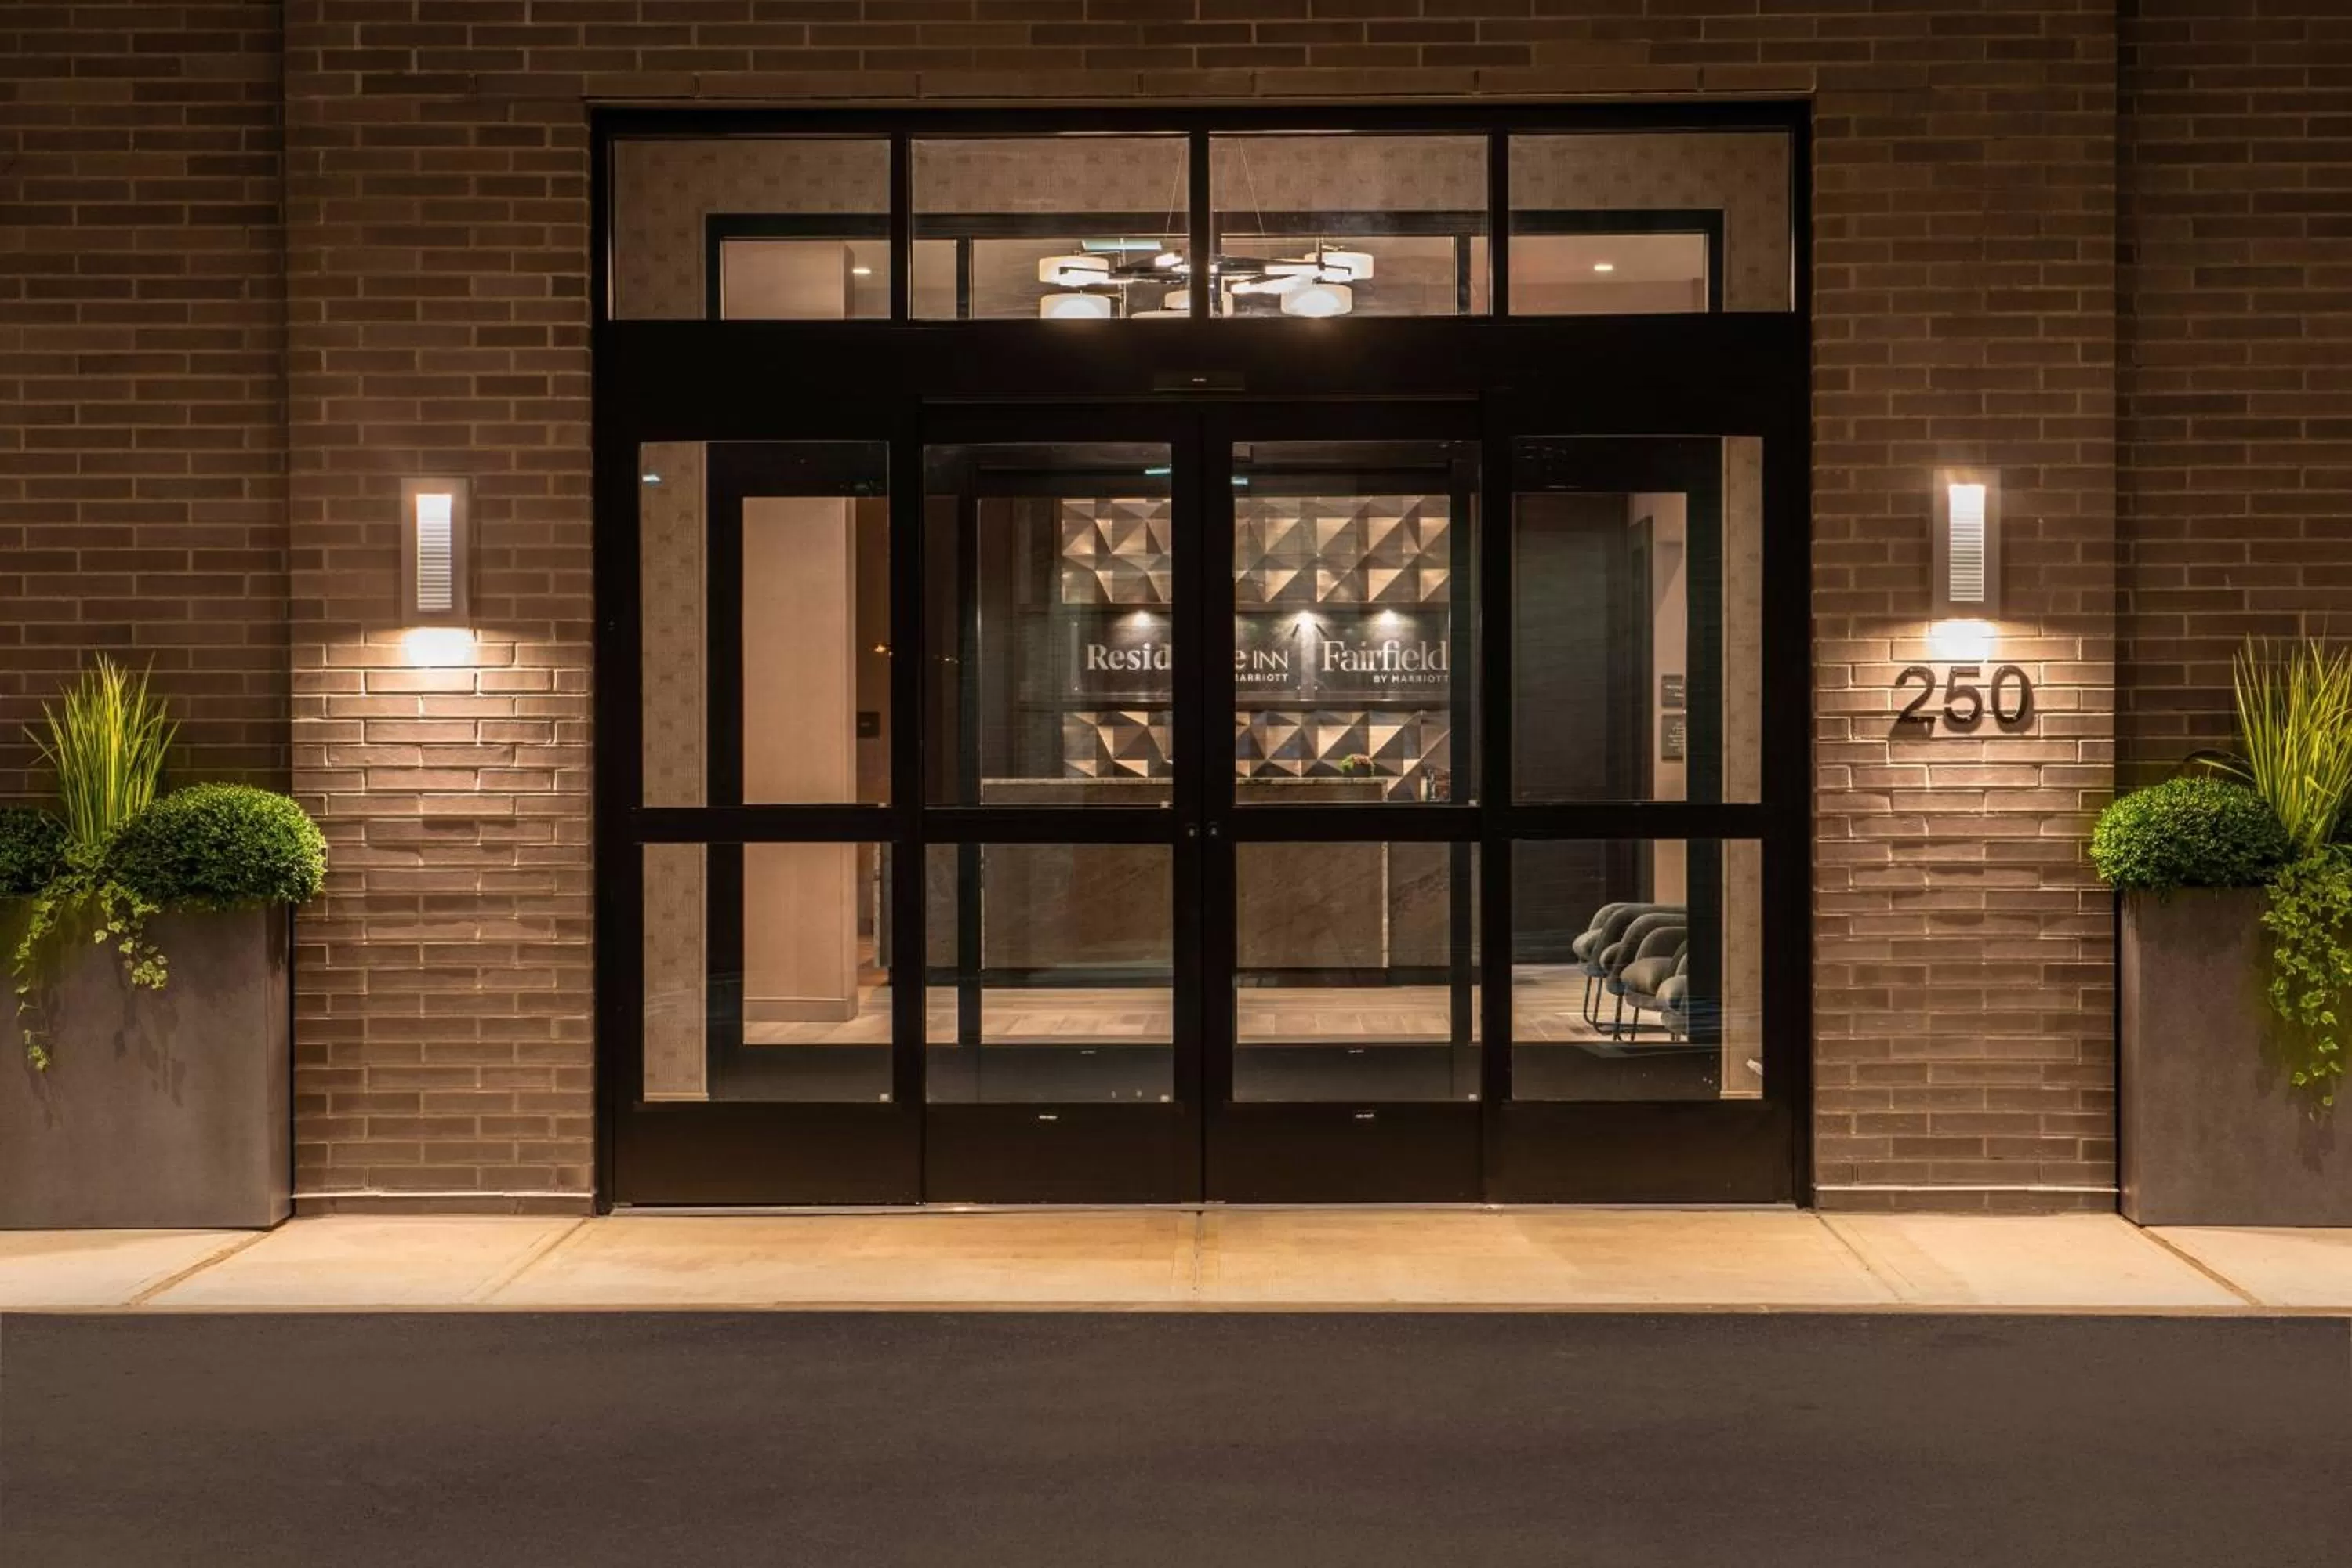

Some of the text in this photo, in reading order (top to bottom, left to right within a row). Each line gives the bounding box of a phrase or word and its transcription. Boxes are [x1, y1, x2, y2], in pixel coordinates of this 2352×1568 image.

[1087, 643, 1288, 670] Reside INN
[1321, 639, 1449, 672] Fairfield
[1373, 674, 1449, 683] BY MARRIOTT
[1894, 665, 2031, 724] 250
